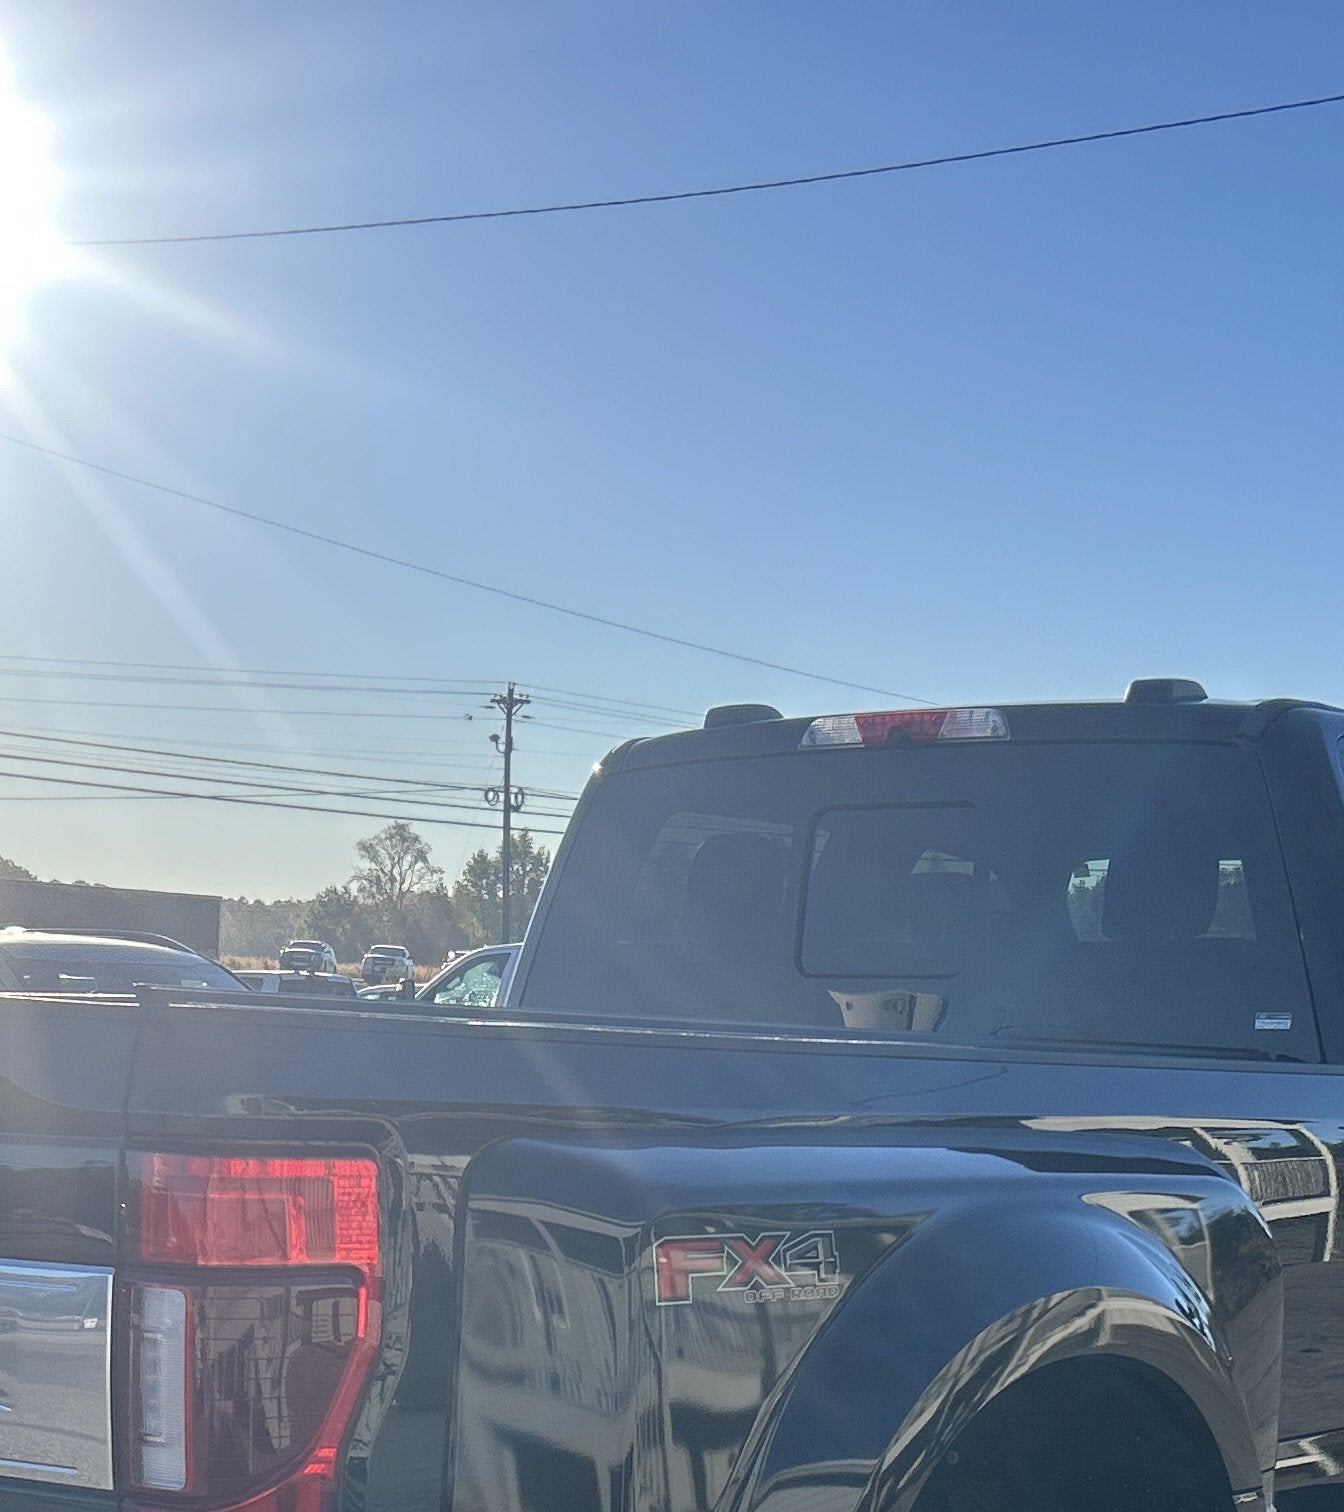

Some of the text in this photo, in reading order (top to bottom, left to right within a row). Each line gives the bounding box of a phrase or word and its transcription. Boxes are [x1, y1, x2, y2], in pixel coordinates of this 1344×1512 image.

[653, 1230, 841, 1306] FX4
[743, 1285, 841, 1303] OFF ROAD
